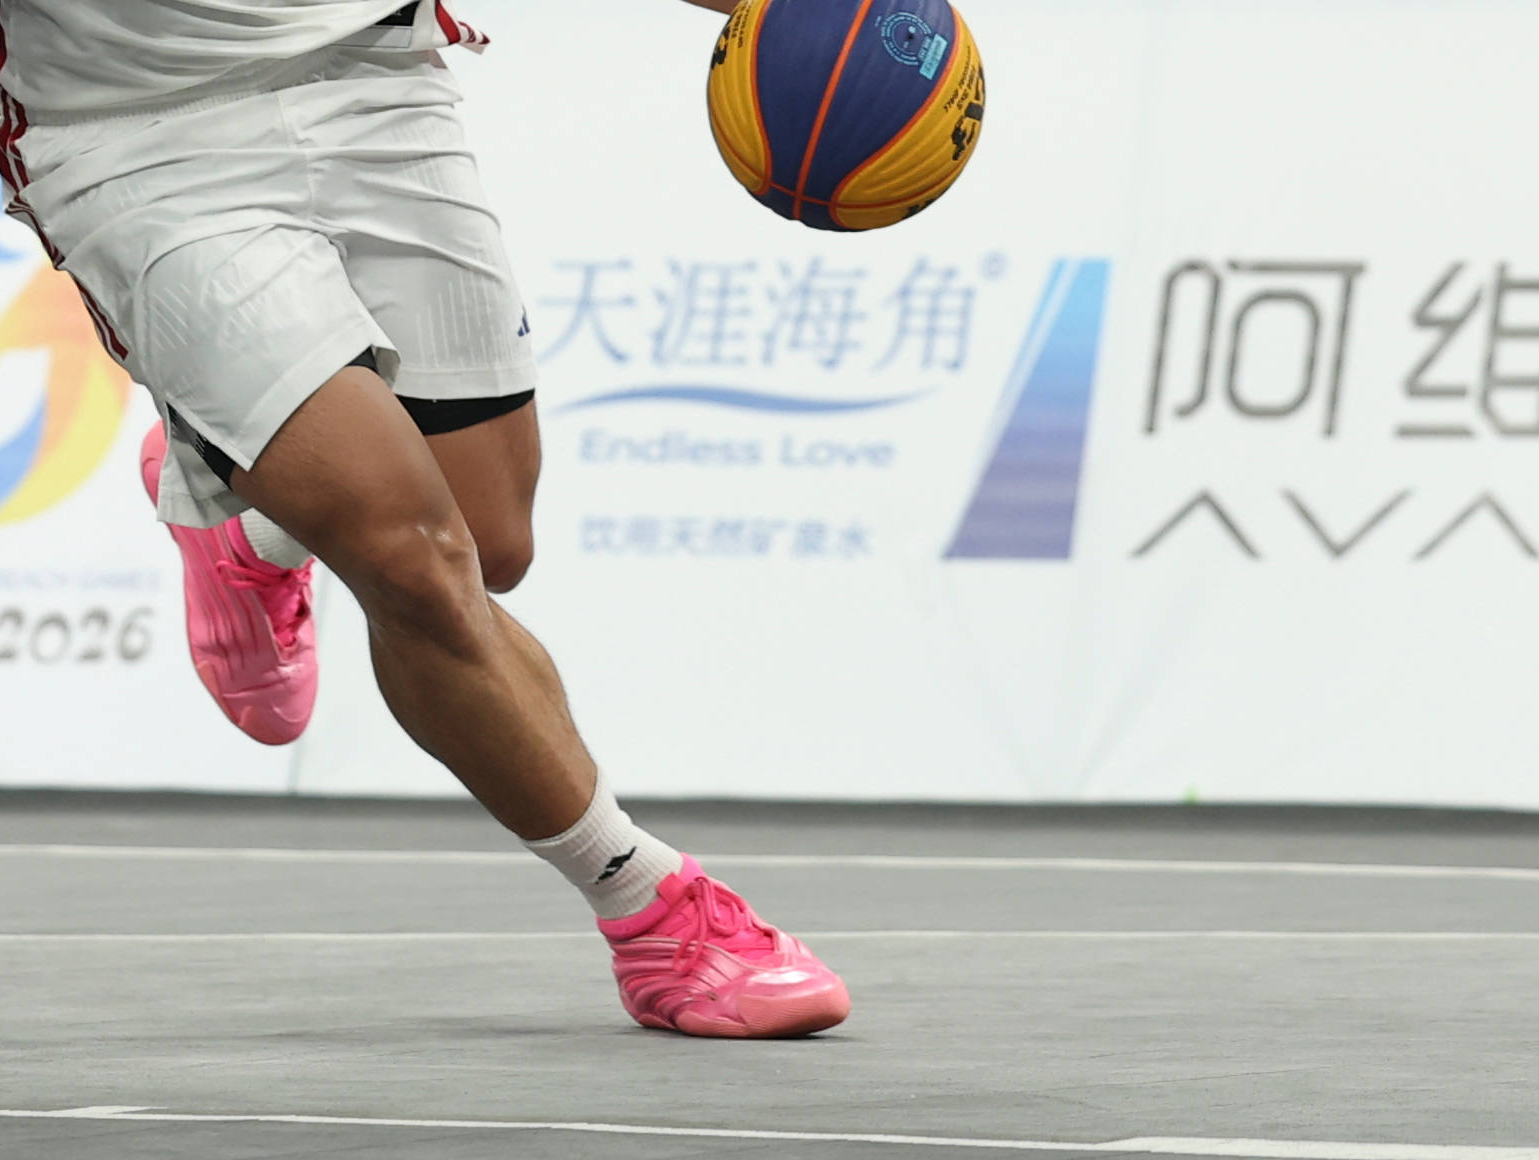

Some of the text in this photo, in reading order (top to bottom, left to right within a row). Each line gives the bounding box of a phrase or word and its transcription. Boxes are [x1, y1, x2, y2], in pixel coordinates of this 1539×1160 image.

[536, 256, 978, 372] 天涯海角
[1143, 259, 1539, 440] 阿维
[578, 428, 897, 467] Endless Love
